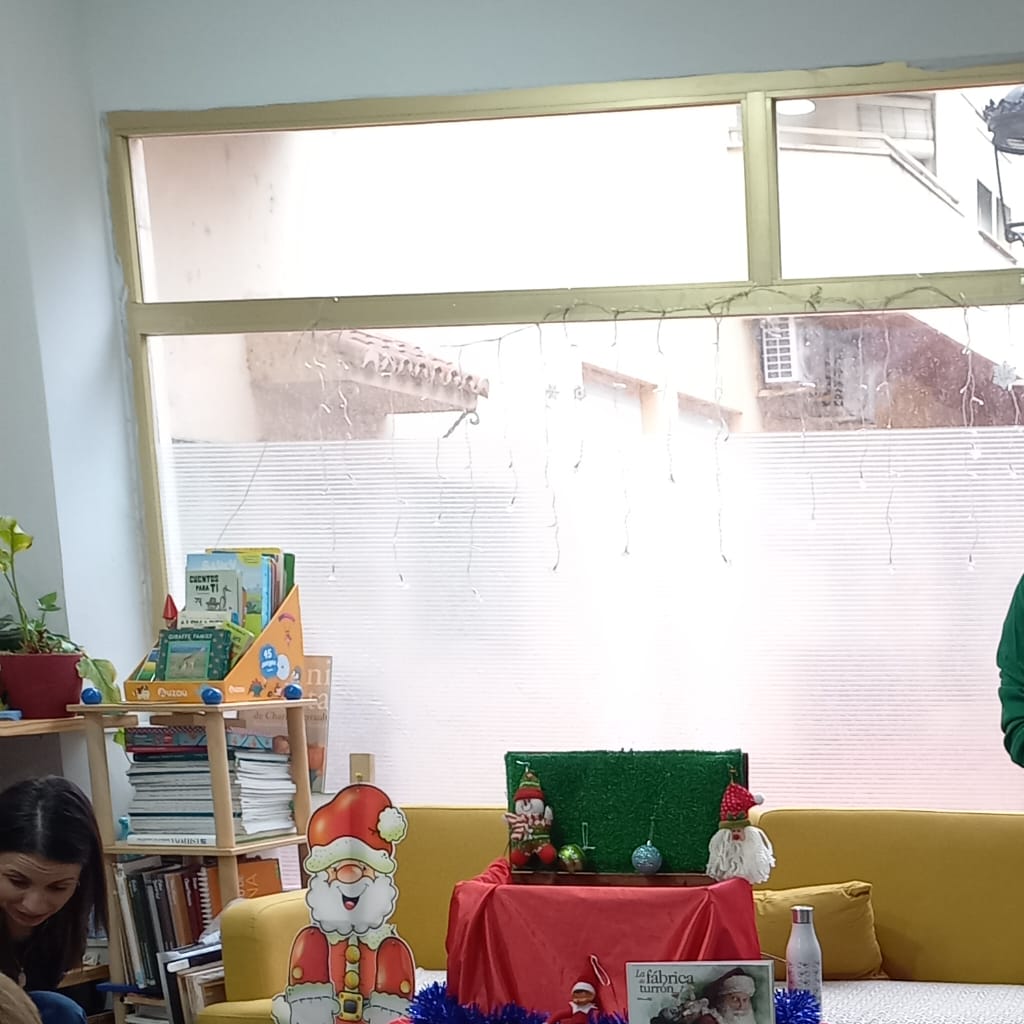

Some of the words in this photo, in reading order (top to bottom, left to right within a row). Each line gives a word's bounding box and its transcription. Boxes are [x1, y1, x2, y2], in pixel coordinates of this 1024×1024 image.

[189, 574, 219, 583] CUENTOS
[195, 584, 209, 592] PARA
[210, 583, 219, 593] TI
[634, 969, 646, 978] La
[646, 968, 694, 985] fábrica
[639, 983, 674, 993] turrón
